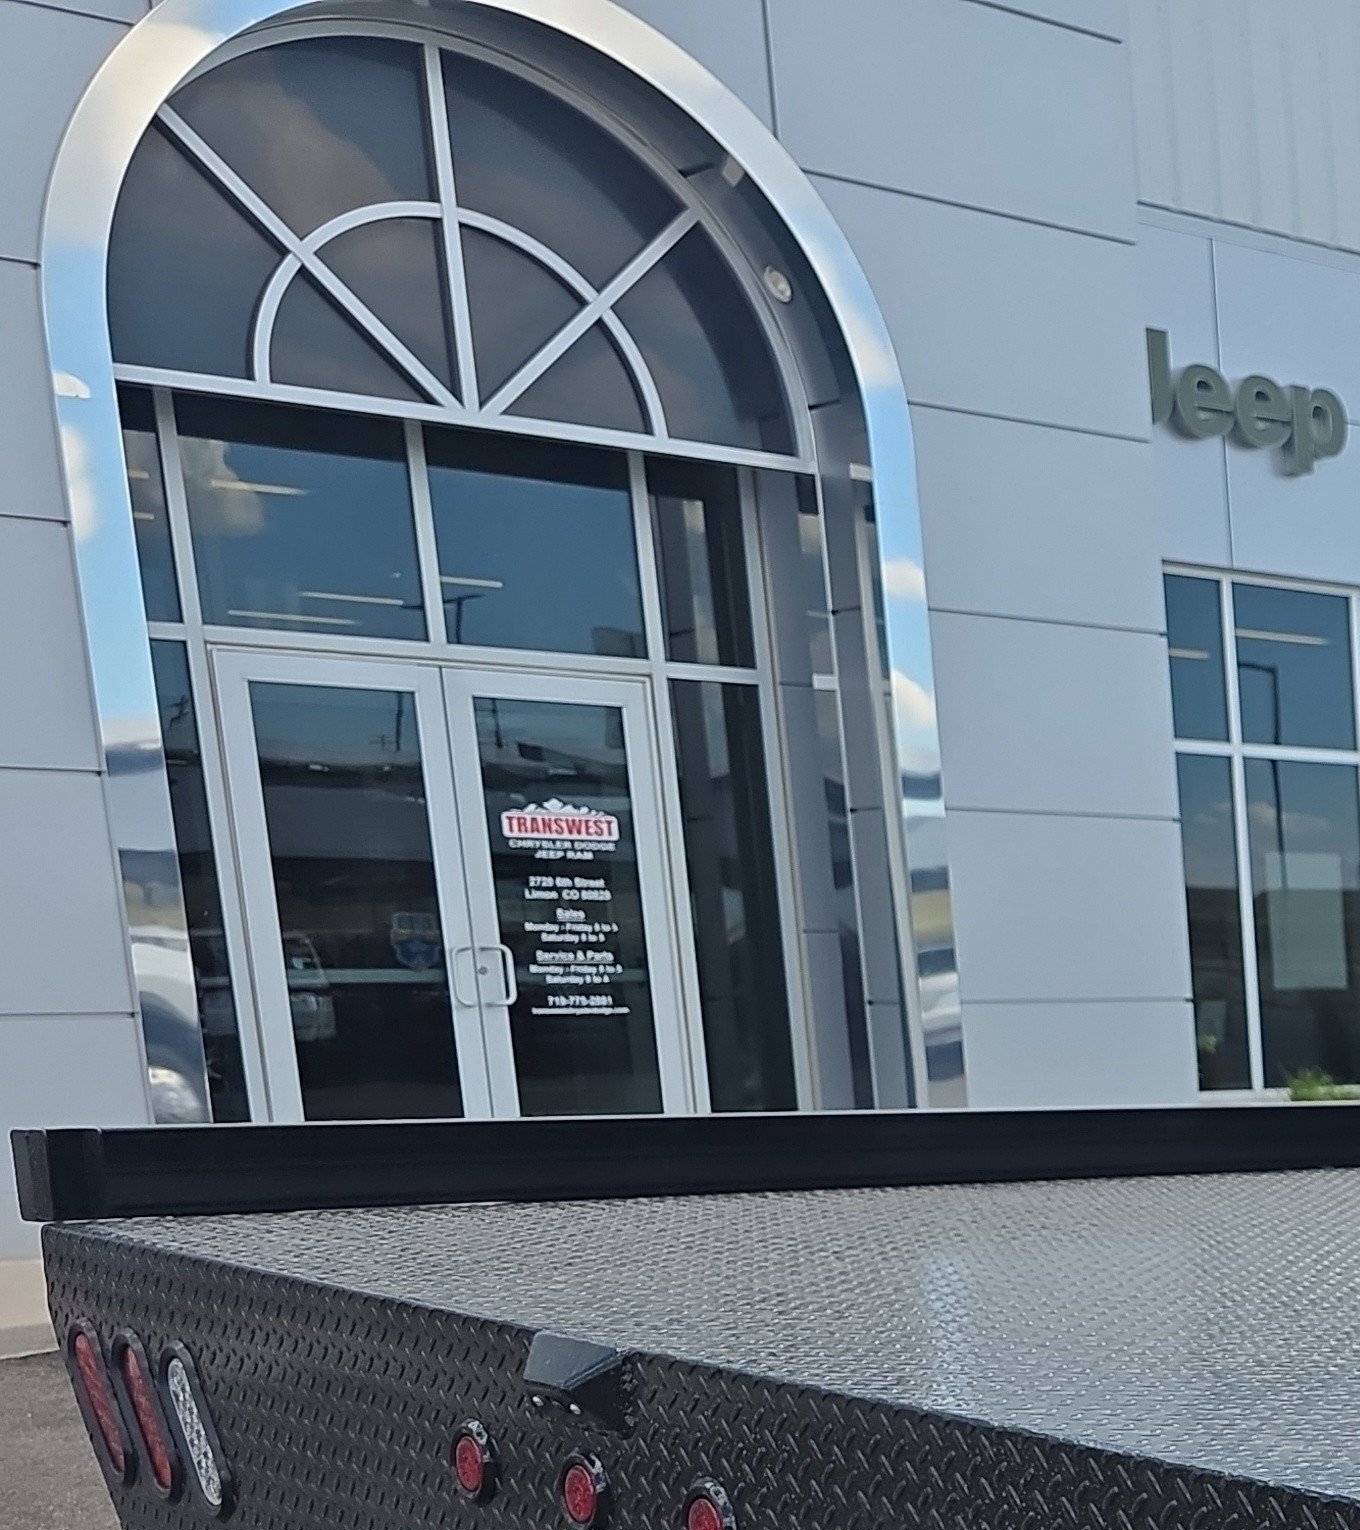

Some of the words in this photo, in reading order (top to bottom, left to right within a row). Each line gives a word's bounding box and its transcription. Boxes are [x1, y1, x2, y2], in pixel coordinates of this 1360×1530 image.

[1146, 327, 1348, 477] Jeep
[506, 815, 614, 837] TRANSWEST
[509, 839, 572, 850] CHRYSLER
[573, 840, 616, 852] DODGE
[534, 850, 565, 859] JEEP
[566, 850, 594, 860] RAM
[574, 877, 606, 888] Street
[562, 889, 580, 900] CO
